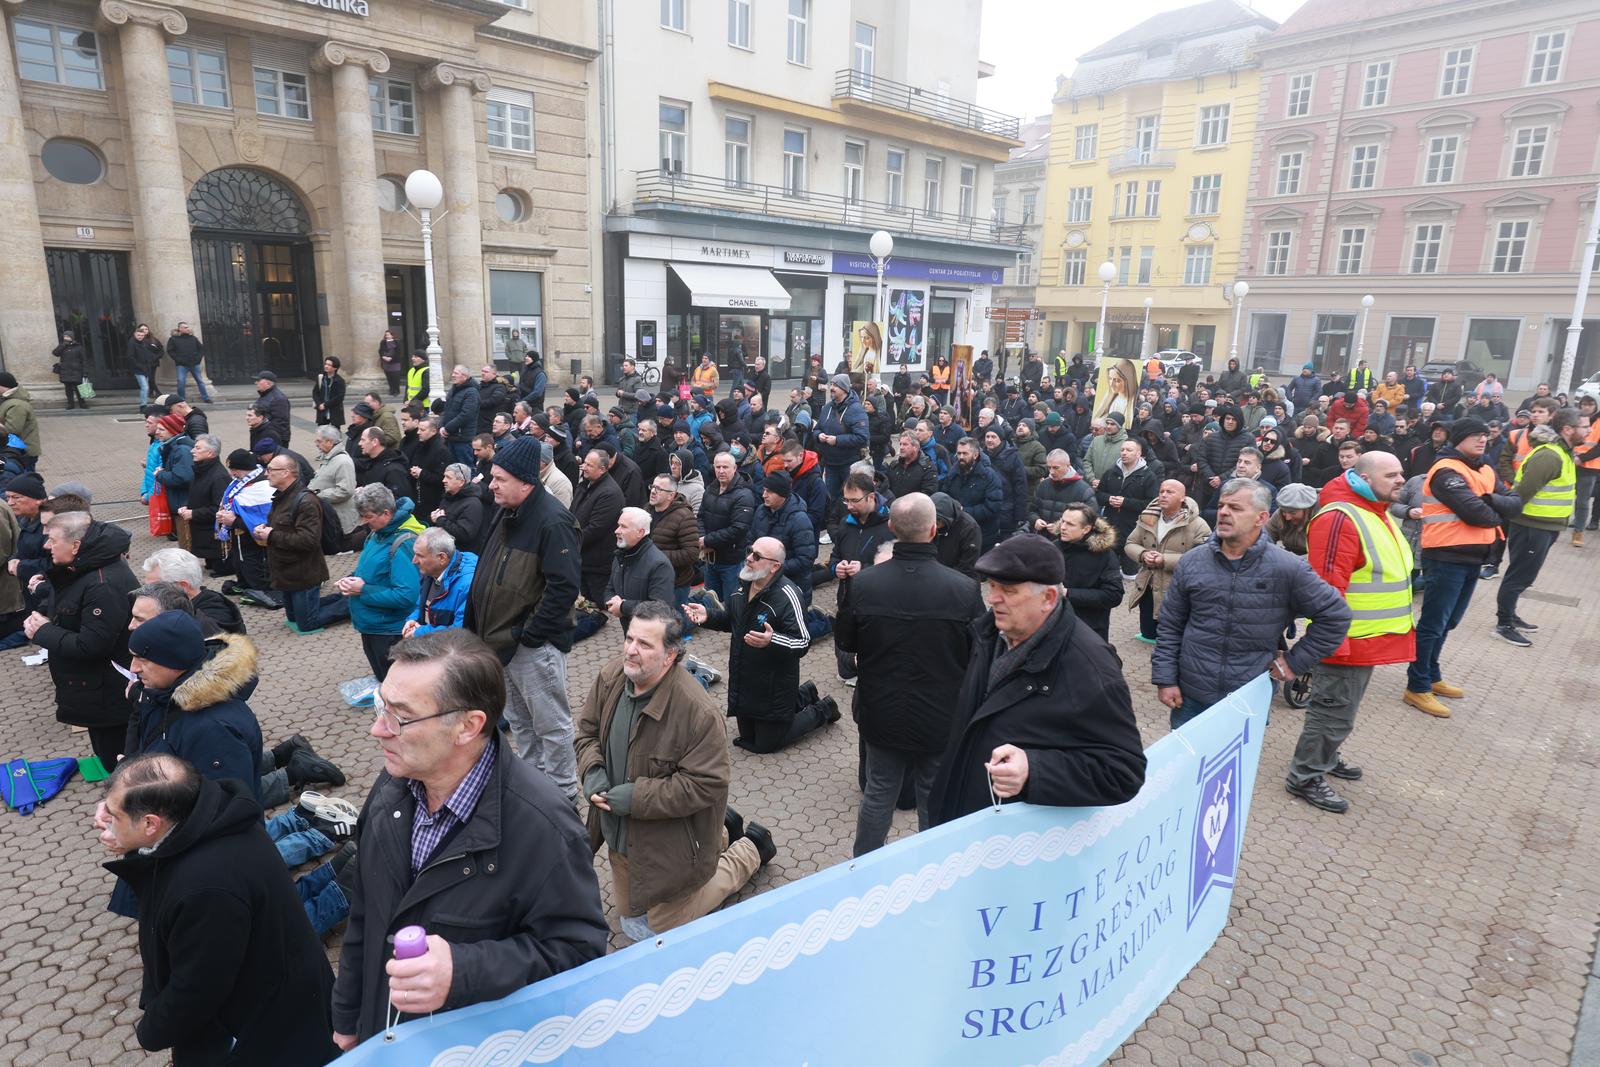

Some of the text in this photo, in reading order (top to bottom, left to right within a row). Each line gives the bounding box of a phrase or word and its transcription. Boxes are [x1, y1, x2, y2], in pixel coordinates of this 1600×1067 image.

[701, 246, 751, 259] MARTIMEX
[849, 261, 871, 269] VISITOR
[728, 299, 758, 307] CHANEL
[976, 807, 1185, 937] VITEZOVI
[967, 848, 1177, 990] BEZGREŠNOG
[960, 894, 1174, 1040] SRCA MARIJINA
